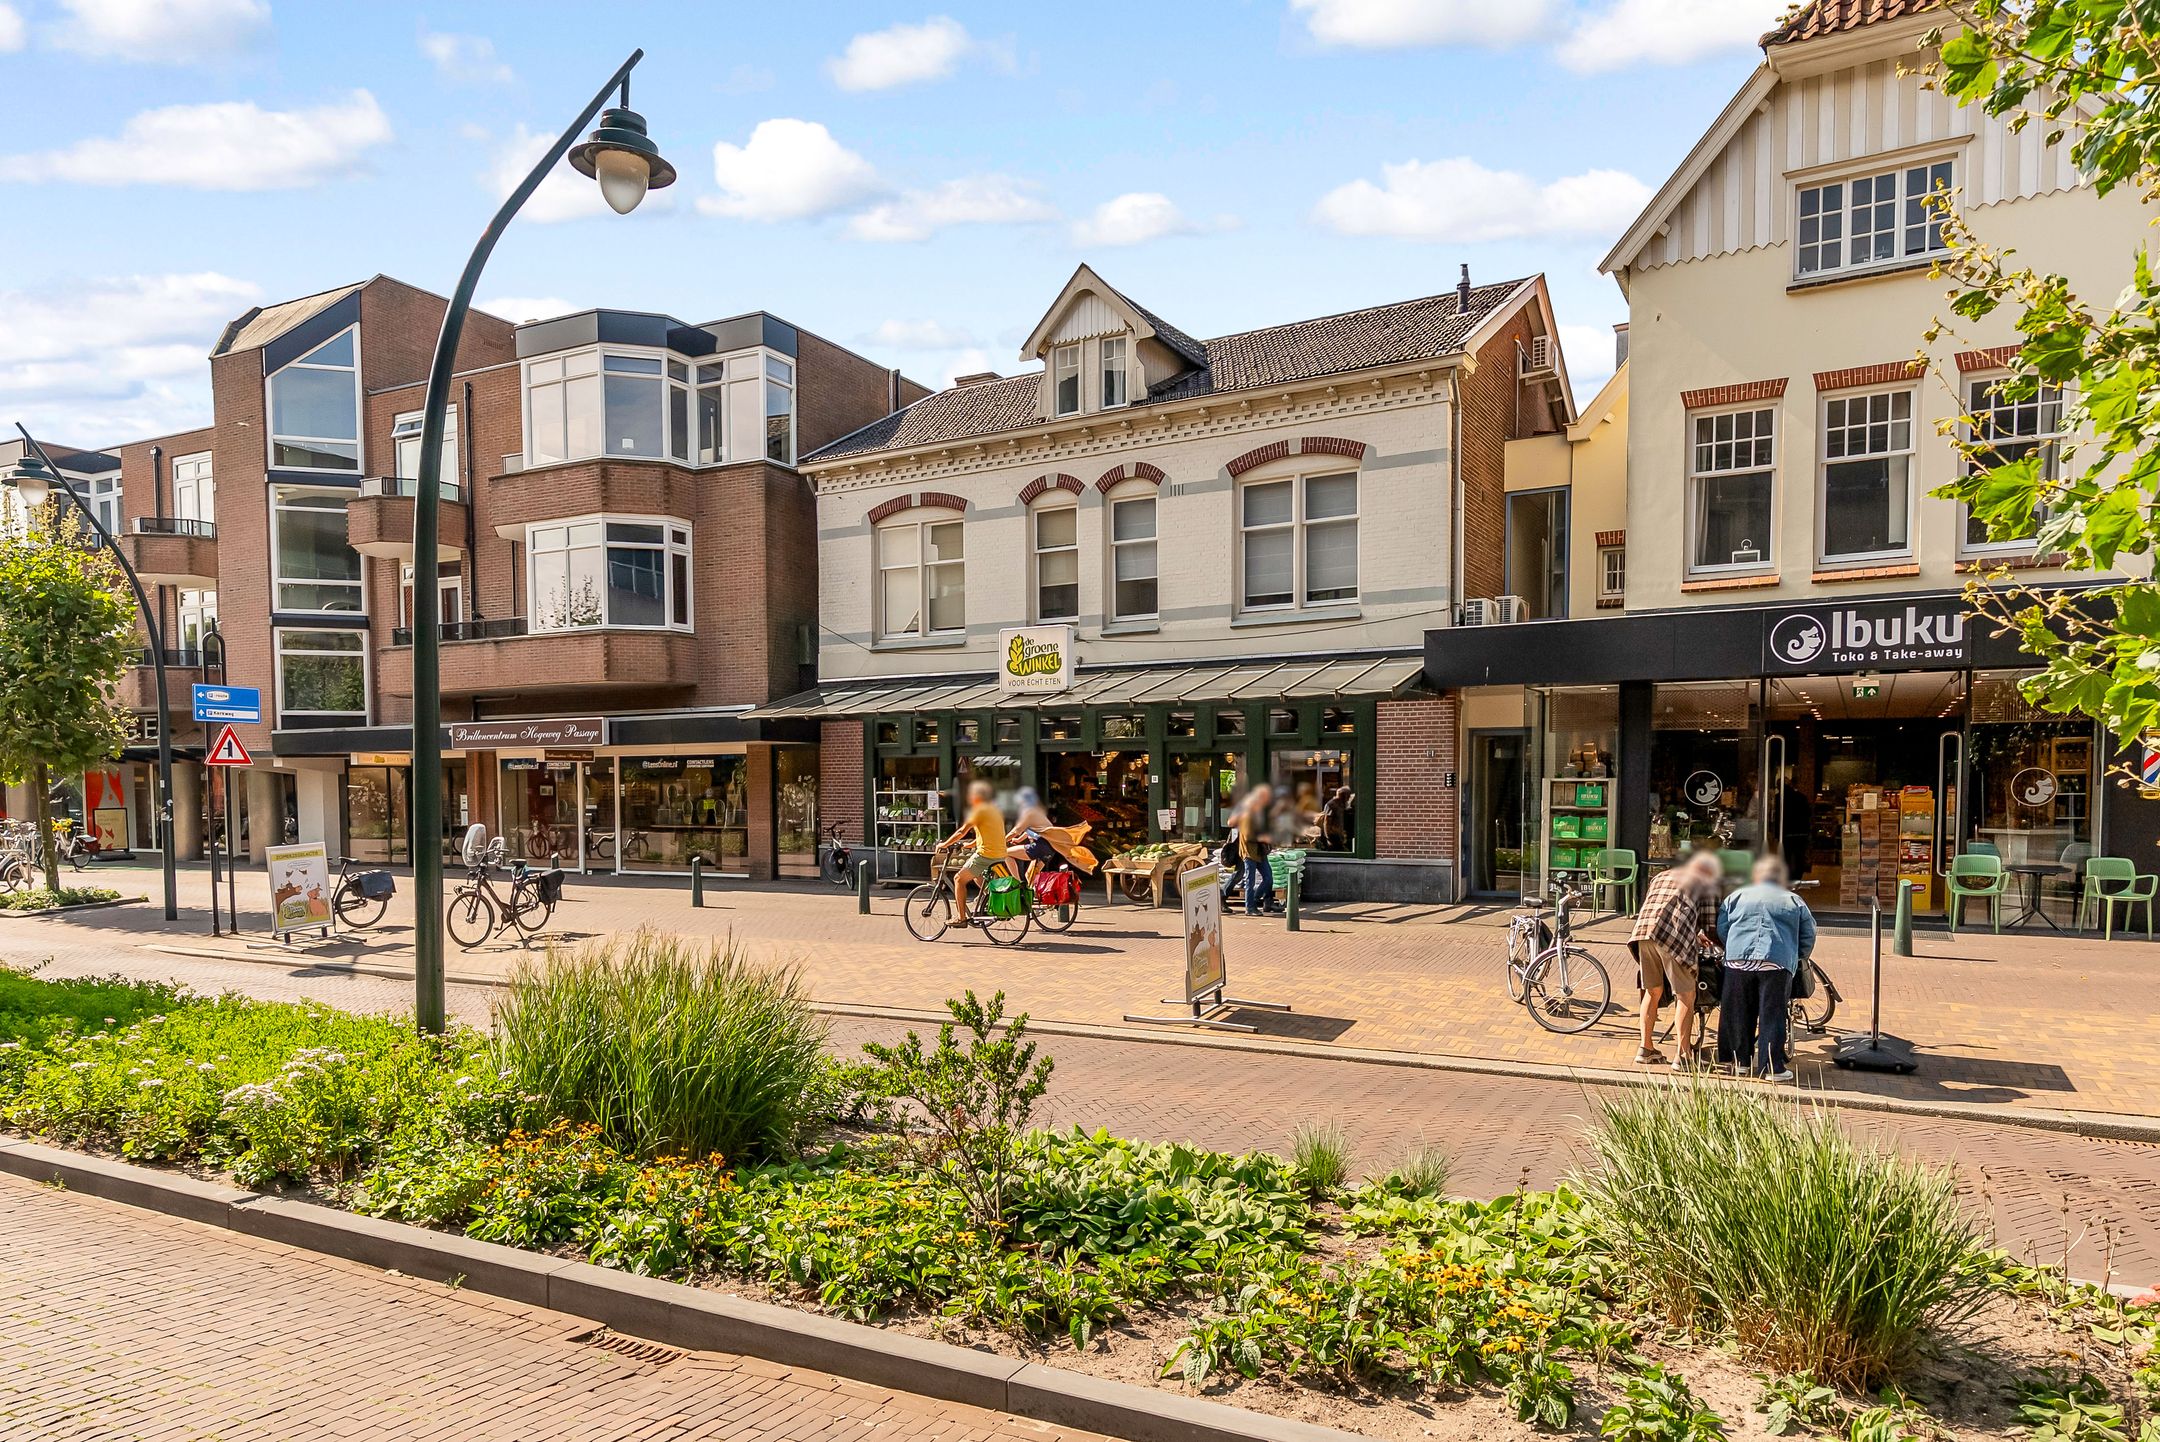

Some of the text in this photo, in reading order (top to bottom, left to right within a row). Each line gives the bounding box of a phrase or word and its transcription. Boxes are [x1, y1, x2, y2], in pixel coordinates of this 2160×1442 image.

[1832, 607, 1963, 648] Ibuku
[1025, 638, 1035, 646] de
[1025, 643, 1059, 658] groene
[1832, 648, 1963, 662] Toko & Take-away
[1019, 653, 1060, 675] WINKEL
[1008, 679, 1025, 687] VOOR
[455, 724, 600, 744] Brillencentrum Hogeweg Passage
